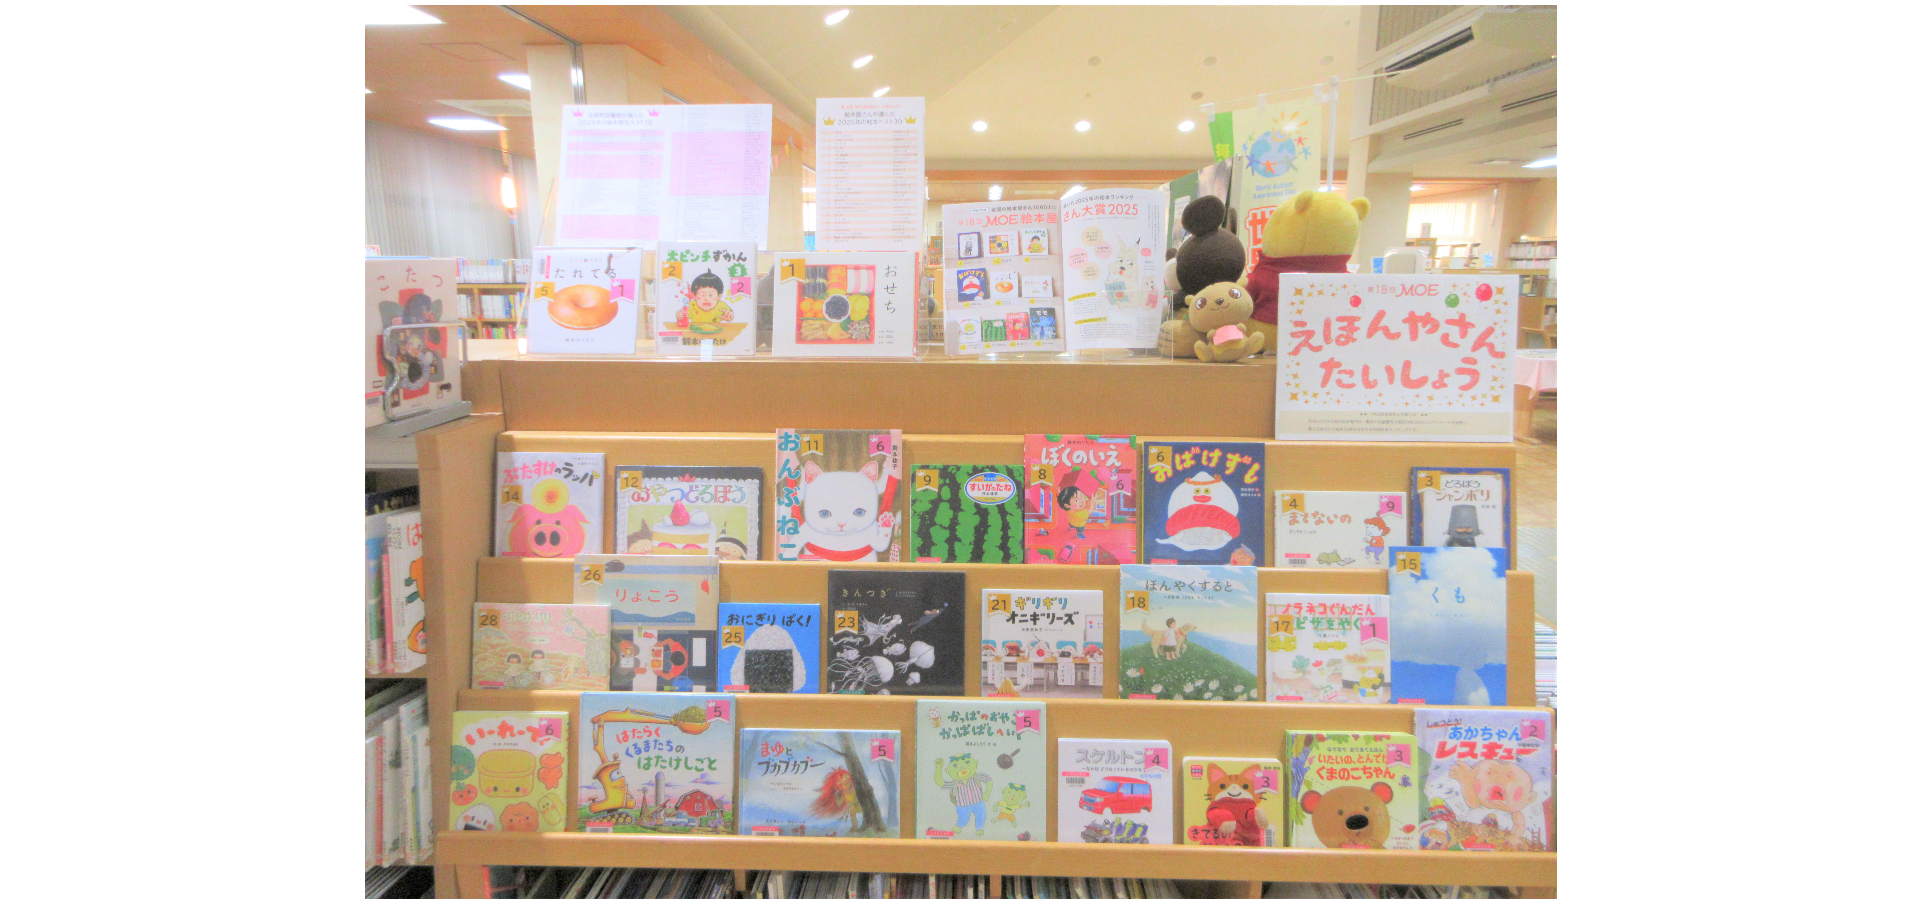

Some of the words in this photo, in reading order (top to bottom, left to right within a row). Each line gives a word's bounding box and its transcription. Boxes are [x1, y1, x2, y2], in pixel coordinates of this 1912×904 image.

[1255, 182, 1272, 191] World
[1272, 181, 1294, 191] Autism
[1253, 189, 1284, 199] Awareness
[1284, 188, 1297, 197] Day
[1063, 203, 1139, 223] さん大賞2025
[667, 249, 748, 263] 大ピンチずかん
[554, 267, 617, 280] たれてる
[668, 265, 677, 276] 2
[733, 265, 742, 275] 3
[788, 264, 795, 277] 1
[377, 265, 443, 291] こたつ
[540, 286, 549, 296] 5
[618, 284, 624, 295] 1
[736, 282, 745, 293] 2
[884, 264, 898, 314] おせち
[1367, 284, 1396, 295] 第18回
[1395, 283, 1440, 297] MOE
[1289, 309, 1507, 359] えほんやさん
[1319, 356, 1481, 392] たいしょう
[805, 439, 819, 451] 11
[876, 441, 885, 452] 6
[1041, 444, 1122, 467] ぼくのいえ
[1156, 451, 1165, 462] 6
[1150, 445, 1261, 484] おばけずし
[503, 459, 597, 487] ぶたすけのラッパ
[1038, 469, 1047, 480] 8
[623, 476, 639, 488] 12
[923, 475, 932, 486] 9
[969, 482, 1013, 492] すいかのたね
[1116, 480, 1125, 491] 6
[1424, 475, 1434, 487] 3
[1444, 479, 1481, 489] どろぼう
[505, 490, 520, 501] 14
[631, 483, 748, 504] おやつどろぼう
[776, 431, 801, 561] おんぶねこ
[1435, 488, 1490, 502] ジャンボリ
[1289, 498, 1299, 509] 4
[1386, 500, 1395, 512] 9
[1288, 511, 1352, 526] まてないの
[1400, 558, 1418, 570] 15
[583, 569, 601, 582] 26
[842, 587, 892, 599] きんつぎ
[1145, 580, 1233, 593] ほんやくすると
[616, 588, 680, 604] りょこう
[1431, 586, 1466, 604] くも
[991, 598, 1008, 611] 21
[1015, 596, 1068, 610] ギリギリ
[1129, 596, 1146, 609] 18
[1282, 601, 1376, 616] ノラネコぐんだん
[479, 613, 499, 627] 28
[726, 613, 777, 627] おにぎり
[837, 616, 856, 629] 23
[1005, 610, 1080, 626] オニギリーズ
[1295, 616, 1361, 631] ピザをやく
[1272, 620, 1291, 633] 17
[1370, 623, 1378, 638] 1
[723, 631, 743, 644] 25
[713, 706, 723, 718] 5
[1023, 715, 1033, 728] 5
[545, 723, 554, 736] 6
[616, 726, 661, 744] はたらく
[1448, 725, 1521, 741] あかちゃん
[1528, 725, 1538, 737] 2
[625, 738, 685, 758] くるまたちの
[760, 741, 793, 758] まゆと
[877, 745, 887, 757] 5
[1435, 740, 1539, 760] レスキュー
[1075, 748, 1145, 765] スケルトン
[1151, 754, 1162, 766] 4
[1393, 750, 1404, 762] 3
[638, 755, 718, 773] はたけしごと
[757, 755, 826, 777] ブカブカブー
[1315, 767, 1396, 782] くまのこちゃん
[1262, 776, 1271, 789] 3
